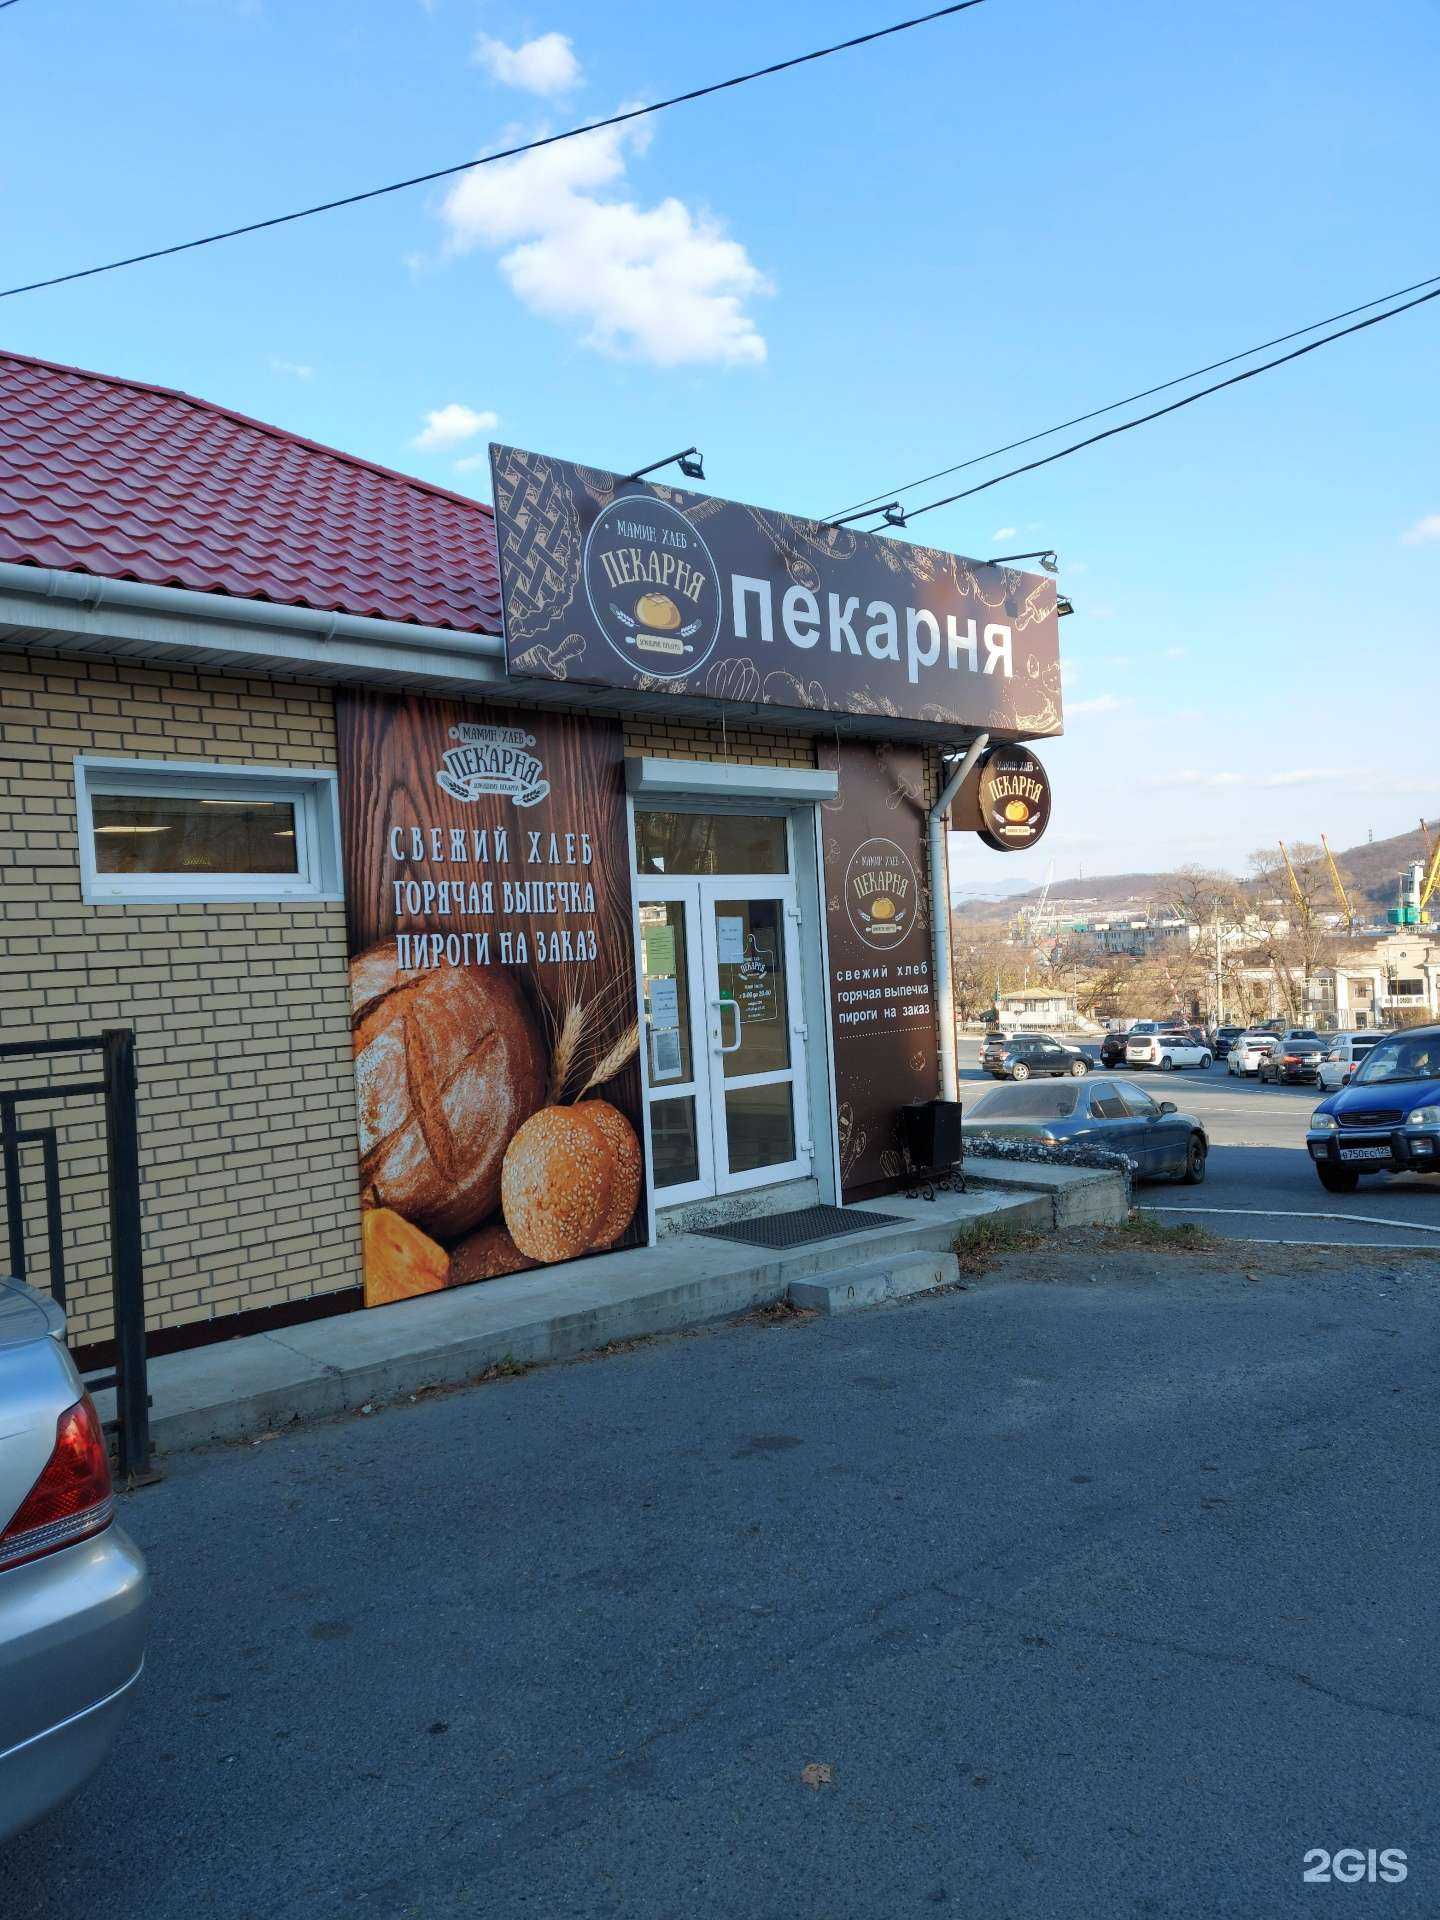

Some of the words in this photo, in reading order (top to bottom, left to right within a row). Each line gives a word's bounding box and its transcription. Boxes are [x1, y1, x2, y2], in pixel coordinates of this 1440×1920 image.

[617, 519, 657, 543] МАМИН
[662, 529, 687, 549] ХЛЕБ
[600, 547, 706, 603] ПЕКАРНЯ
[731, 573, 1015, 685] пекарня
[462, 727, 497, 741] МАМИН
[502, 730, 524, 744] ХЛЕБ
[446, 744, 540, 785] ПЕКАРНЯ
[988, 775, 1043, 804] ПЕКАРНЯ
[390, 825, 509, 864] СВЕЖИЙ
[527, 831, 593, 866] ХЛЕБ
[393, 880, 495, 915] ГОРЯЧАЯ
[502, 881, 596, 914] ВЫПЕЧКА
[853, 870, 909, 899] ПЕКАРНЯ
[396, 932, 491, 970] ПИРОГИ
[500, 932, 529, 964] НА
[536, 930, 597, 963] ЗАКАЗ
[836, 964, 888, 981] свежий
[896, 961, 928, 976] хлеб
[837, 988, 881, 1004] горячая
[884, 984, 929, 998] выпечка
[838, 1009, 878, 1025] пироги
[884, 1007, 896, 1018] на
[902, 1004, 930, 1017] заказ
